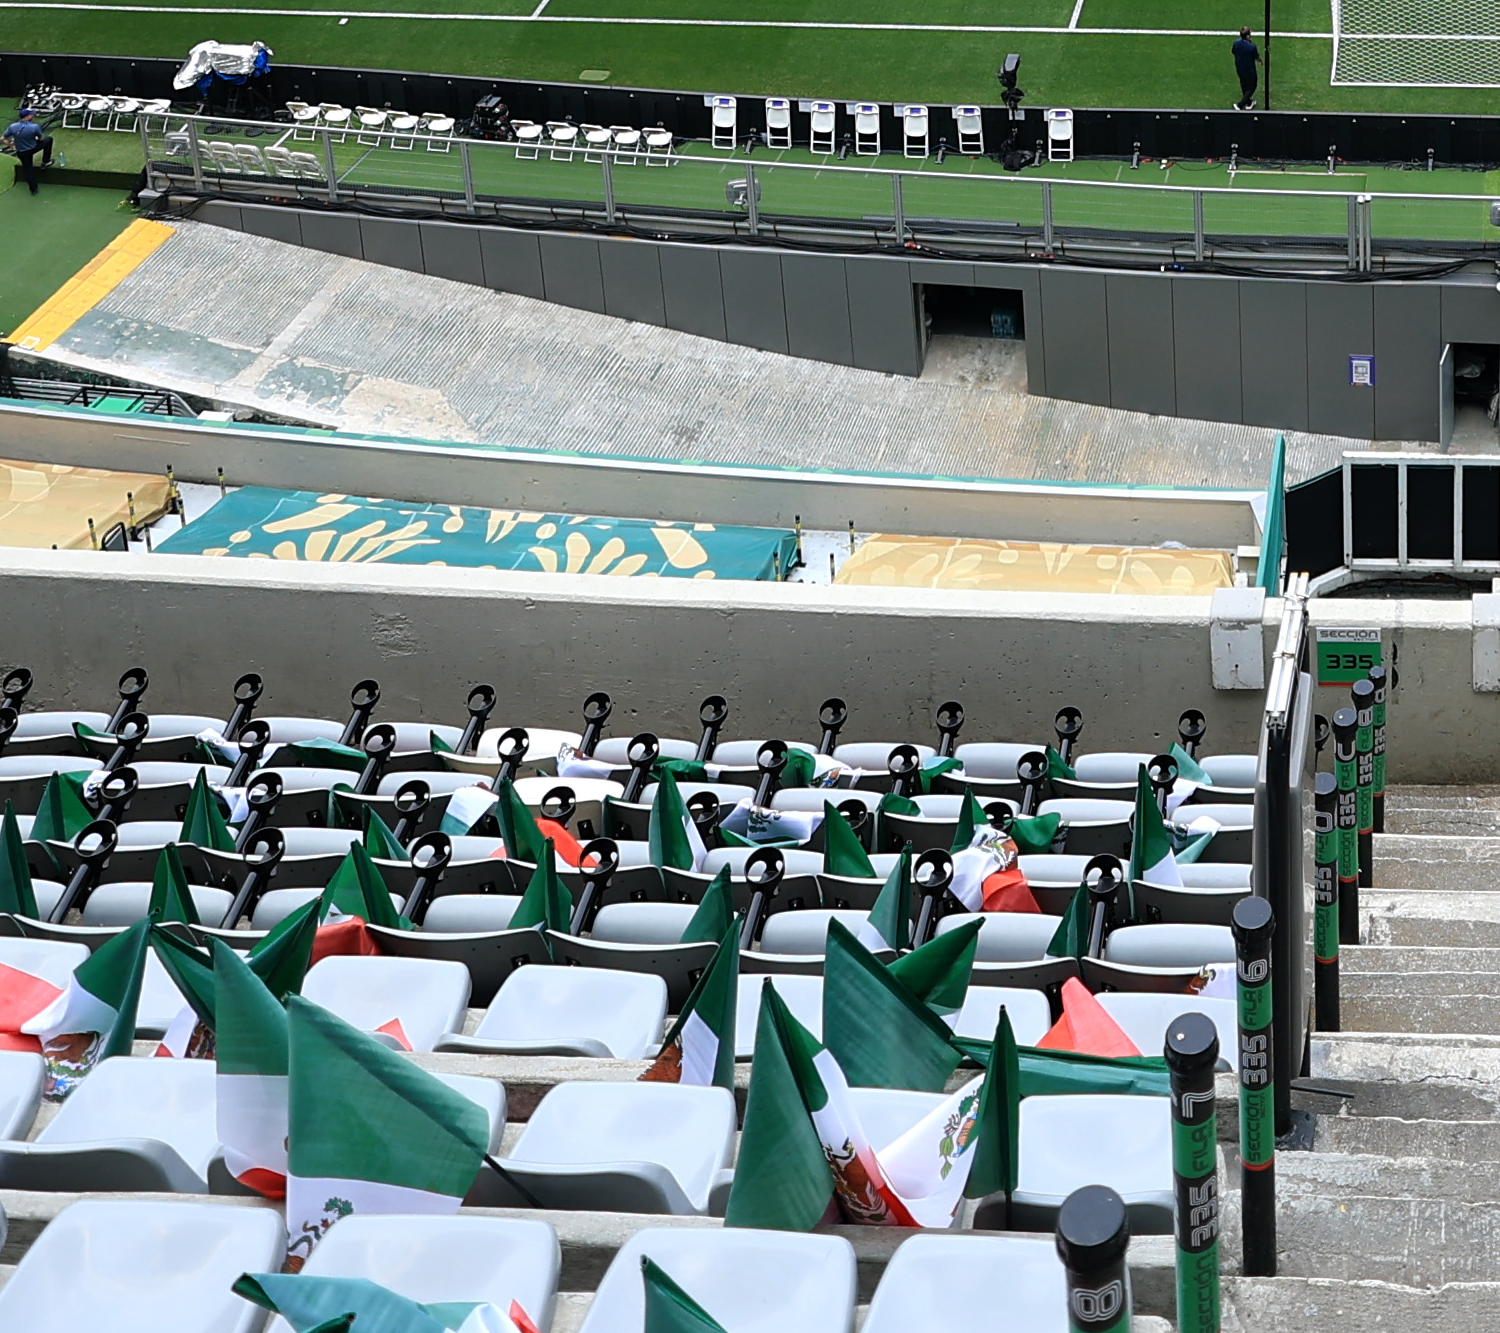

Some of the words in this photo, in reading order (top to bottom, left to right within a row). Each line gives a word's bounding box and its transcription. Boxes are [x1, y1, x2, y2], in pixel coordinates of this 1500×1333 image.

[1320, 627, 1379, 639] SECCIÓN
[1325, 654, 1374, 670] 335
[1337, 740, 1357, 762] C
[1339, 791, 1356, 827] 335
[1343, 832, 1351, 877] SECCIÓN
[1315, 866, 1332, 904] 335
[1238, 957, 1269, 983] 6
[1243, 989, 1258, 1028] FILA
[1242, 1034, 1268, 1086] 335
[1181, 1087, 1216, 1119] 7
[1192, 1122, 1208, 1172] FILA
[1248, 1094, 1260, 1163] SECCIÓN
[1190, 1175, 1219, 1248] 335
[1072, 1278, 1124, 1323] 8
[1197, 1255, 1216, 1333] SECCIÓN
